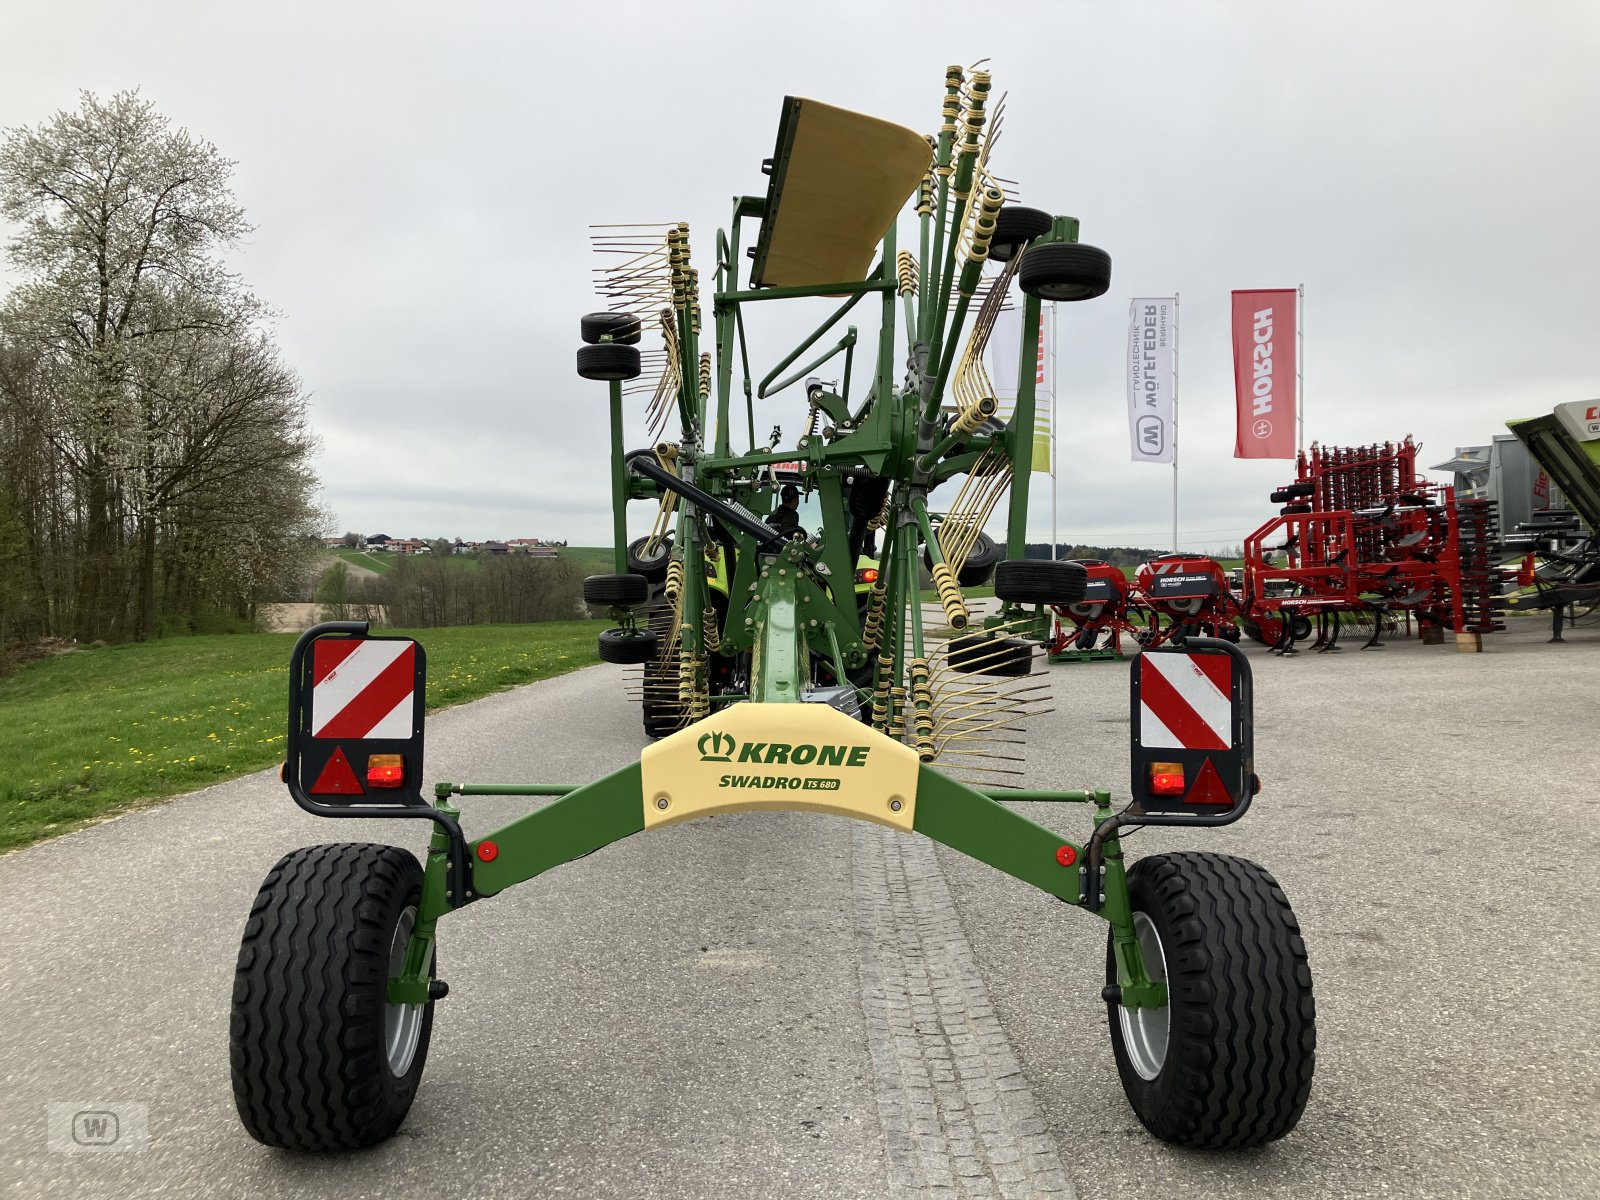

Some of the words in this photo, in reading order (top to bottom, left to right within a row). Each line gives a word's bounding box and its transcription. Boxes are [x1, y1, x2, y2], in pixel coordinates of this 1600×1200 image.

[1534, 466, 1548, 498] Flie
[737, 742, 871, 767] KRONE
[718, 775, 802, 790] SWADRO
[807, 780, 818, 788] TS
[819, 780, 837, 789] 680
